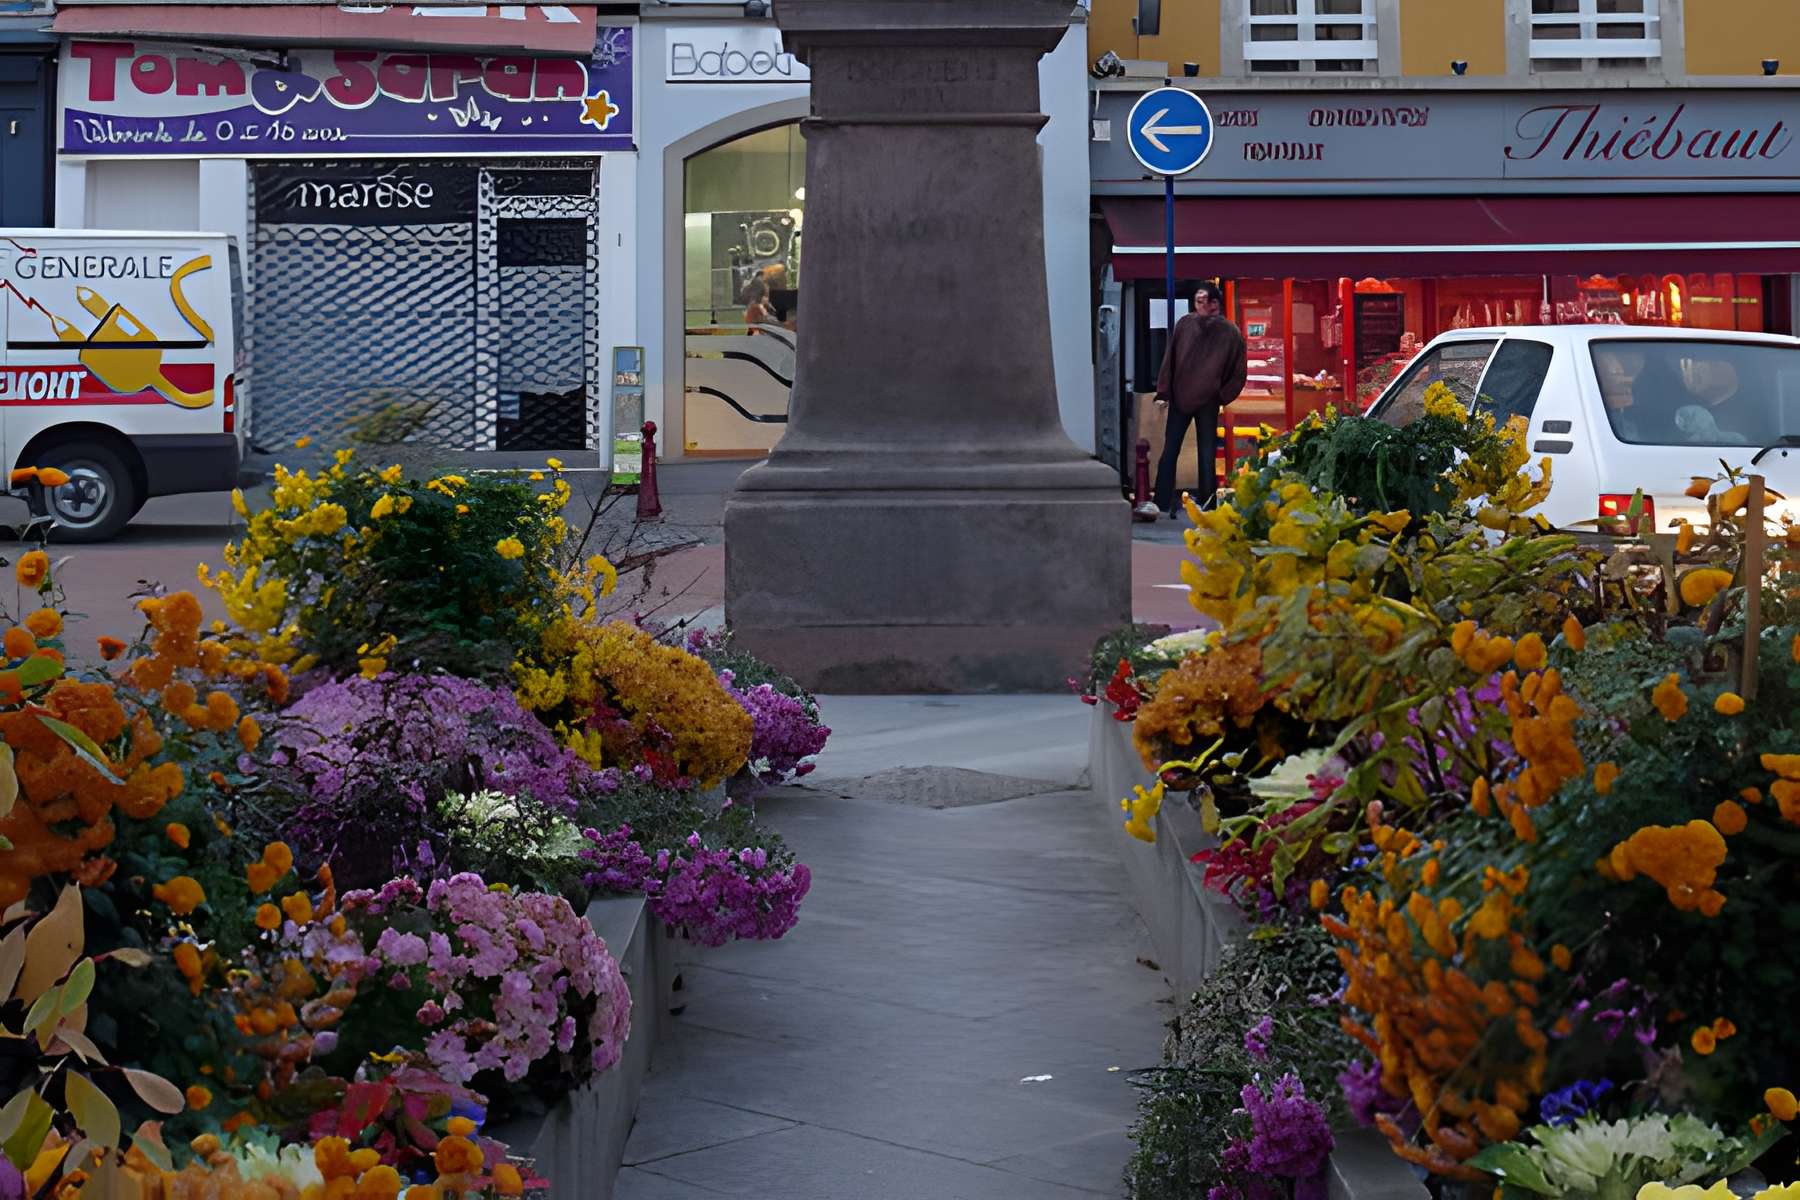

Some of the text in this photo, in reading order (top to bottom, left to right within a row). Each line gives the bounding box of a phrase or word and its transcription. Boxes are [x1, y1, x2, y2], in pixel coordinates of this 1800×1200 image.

[71, 41, 246, 101] Tom
[1503, 102, 1794, 161] Thiébaut
[15, 255, 173, 279] GENERALE
